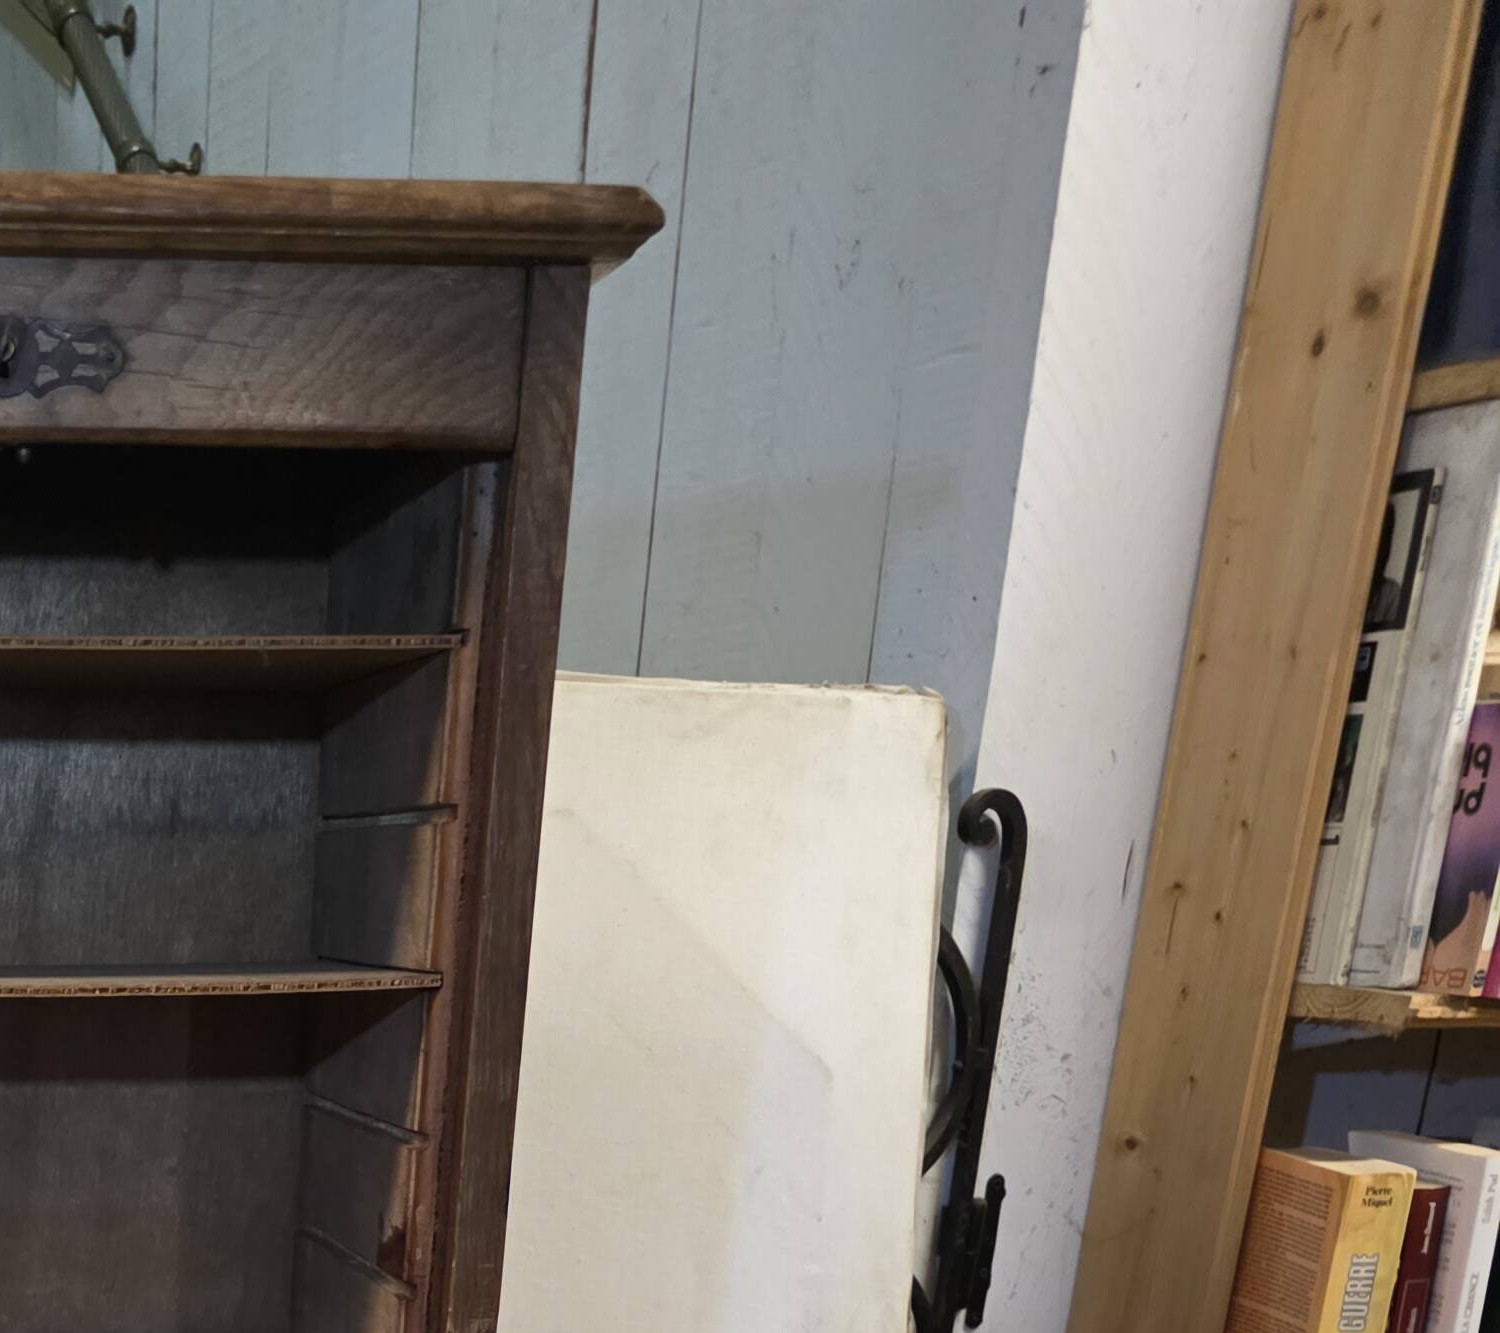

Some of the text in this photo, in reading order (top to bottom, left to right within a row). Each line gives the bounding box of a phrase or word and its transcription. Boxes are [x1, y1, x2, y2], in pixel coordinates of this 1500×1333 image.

[1364, 1185, 1393, 1197] Pierre
[1361, 1197, 1393, 1209] Miquel
[1337, 1253, 1380, 1333] GUERRE
